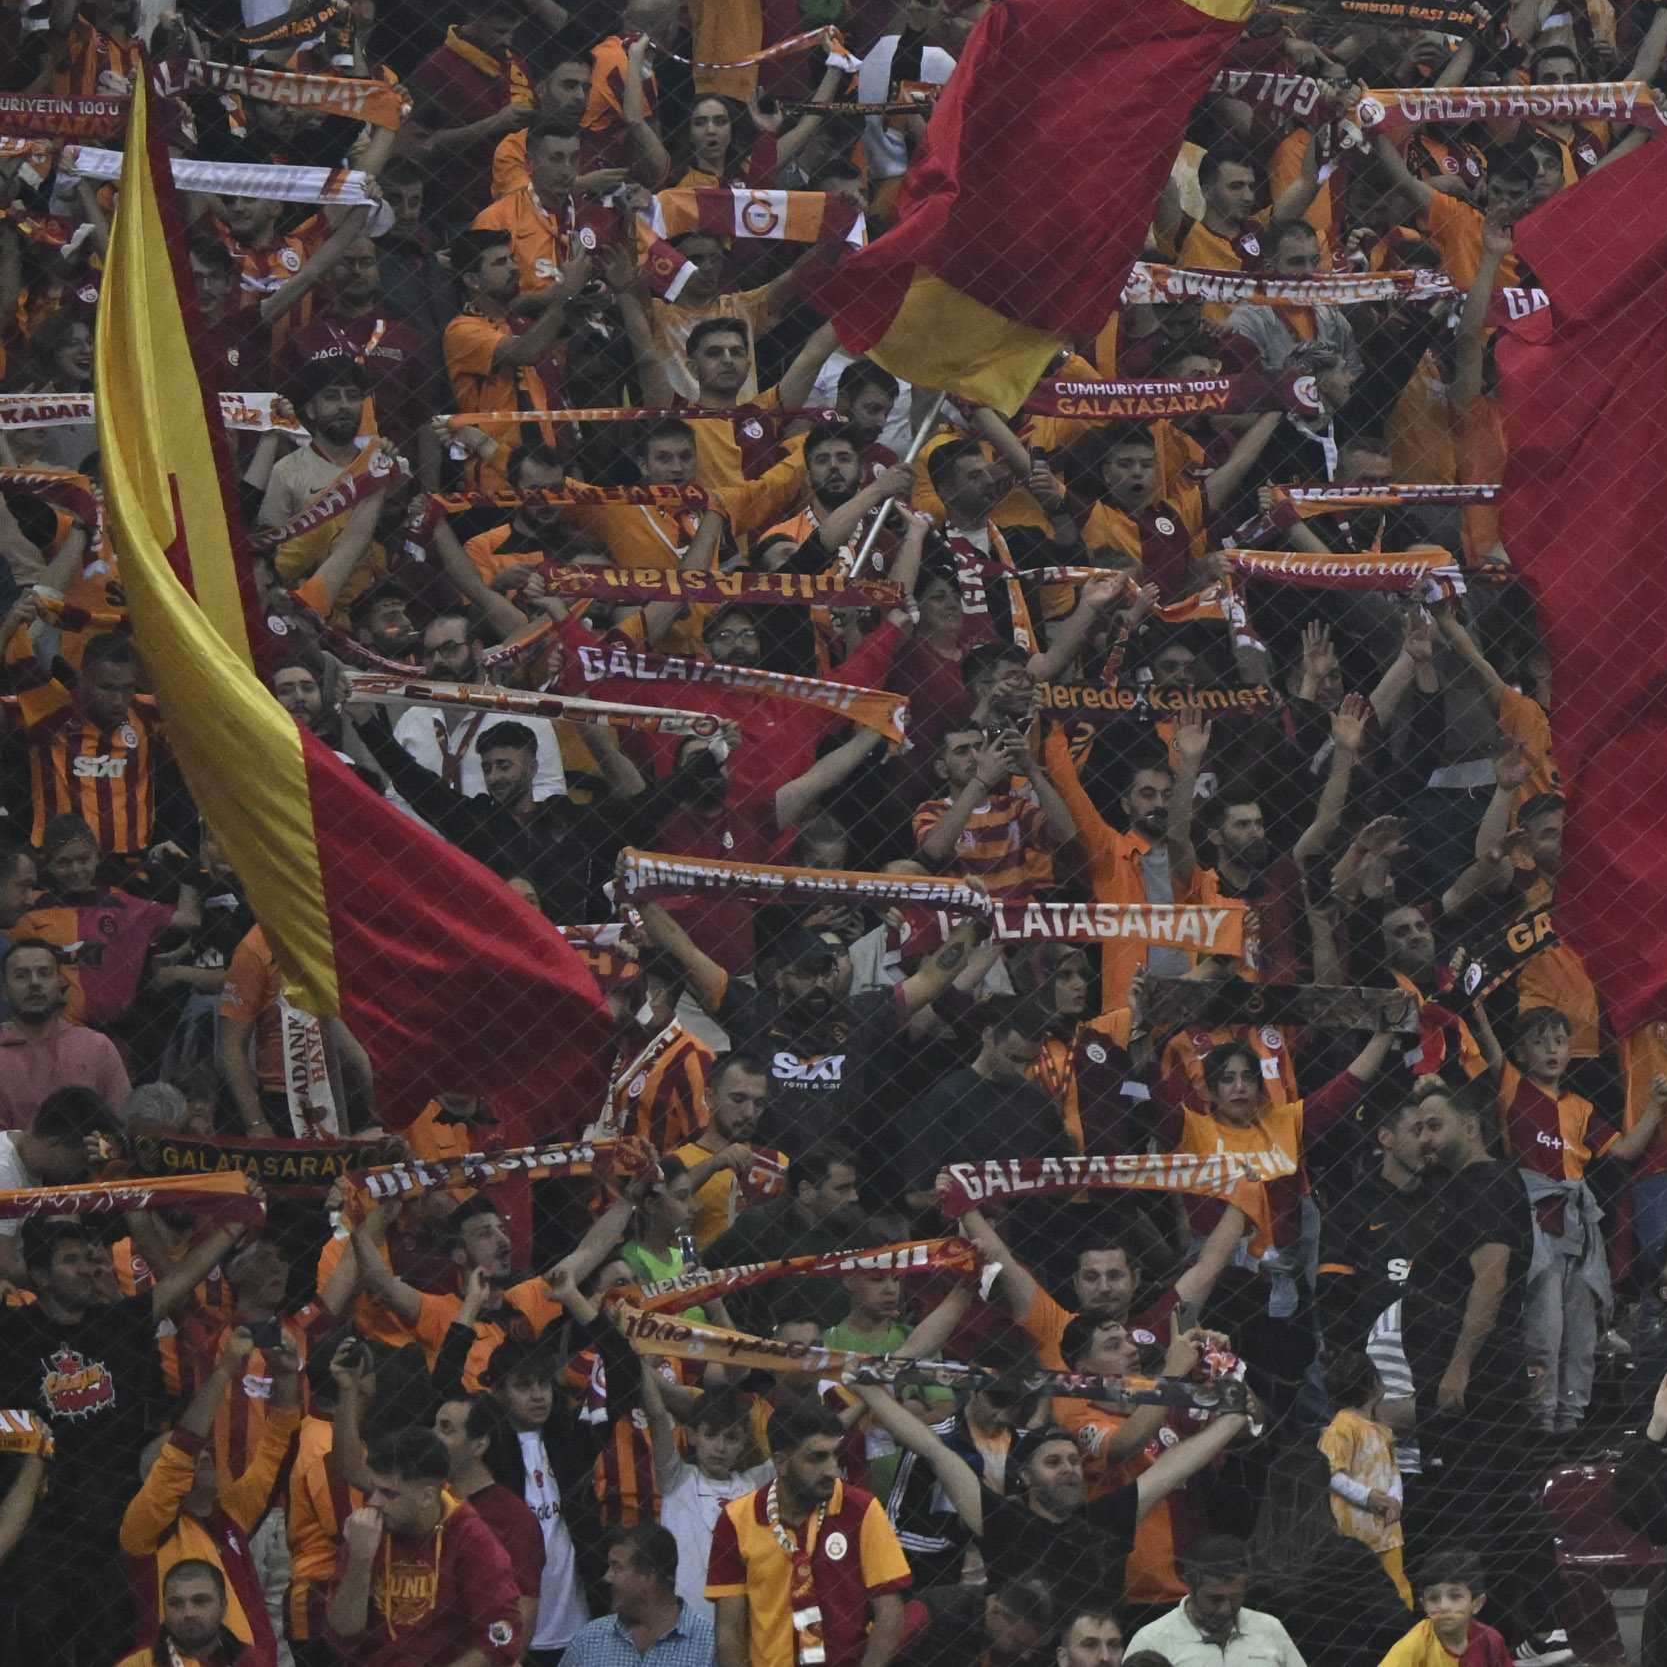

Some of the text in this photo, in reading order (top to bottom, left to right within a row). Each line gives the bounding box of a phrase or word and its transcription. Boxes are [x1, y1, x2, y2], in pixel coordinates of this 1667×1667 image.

[1055, 392, 1232, 417] GALATASARAY
[772, 1051, 847, 1080] SIXT
[163, 1145, 353, 1178] GALATASARAY
